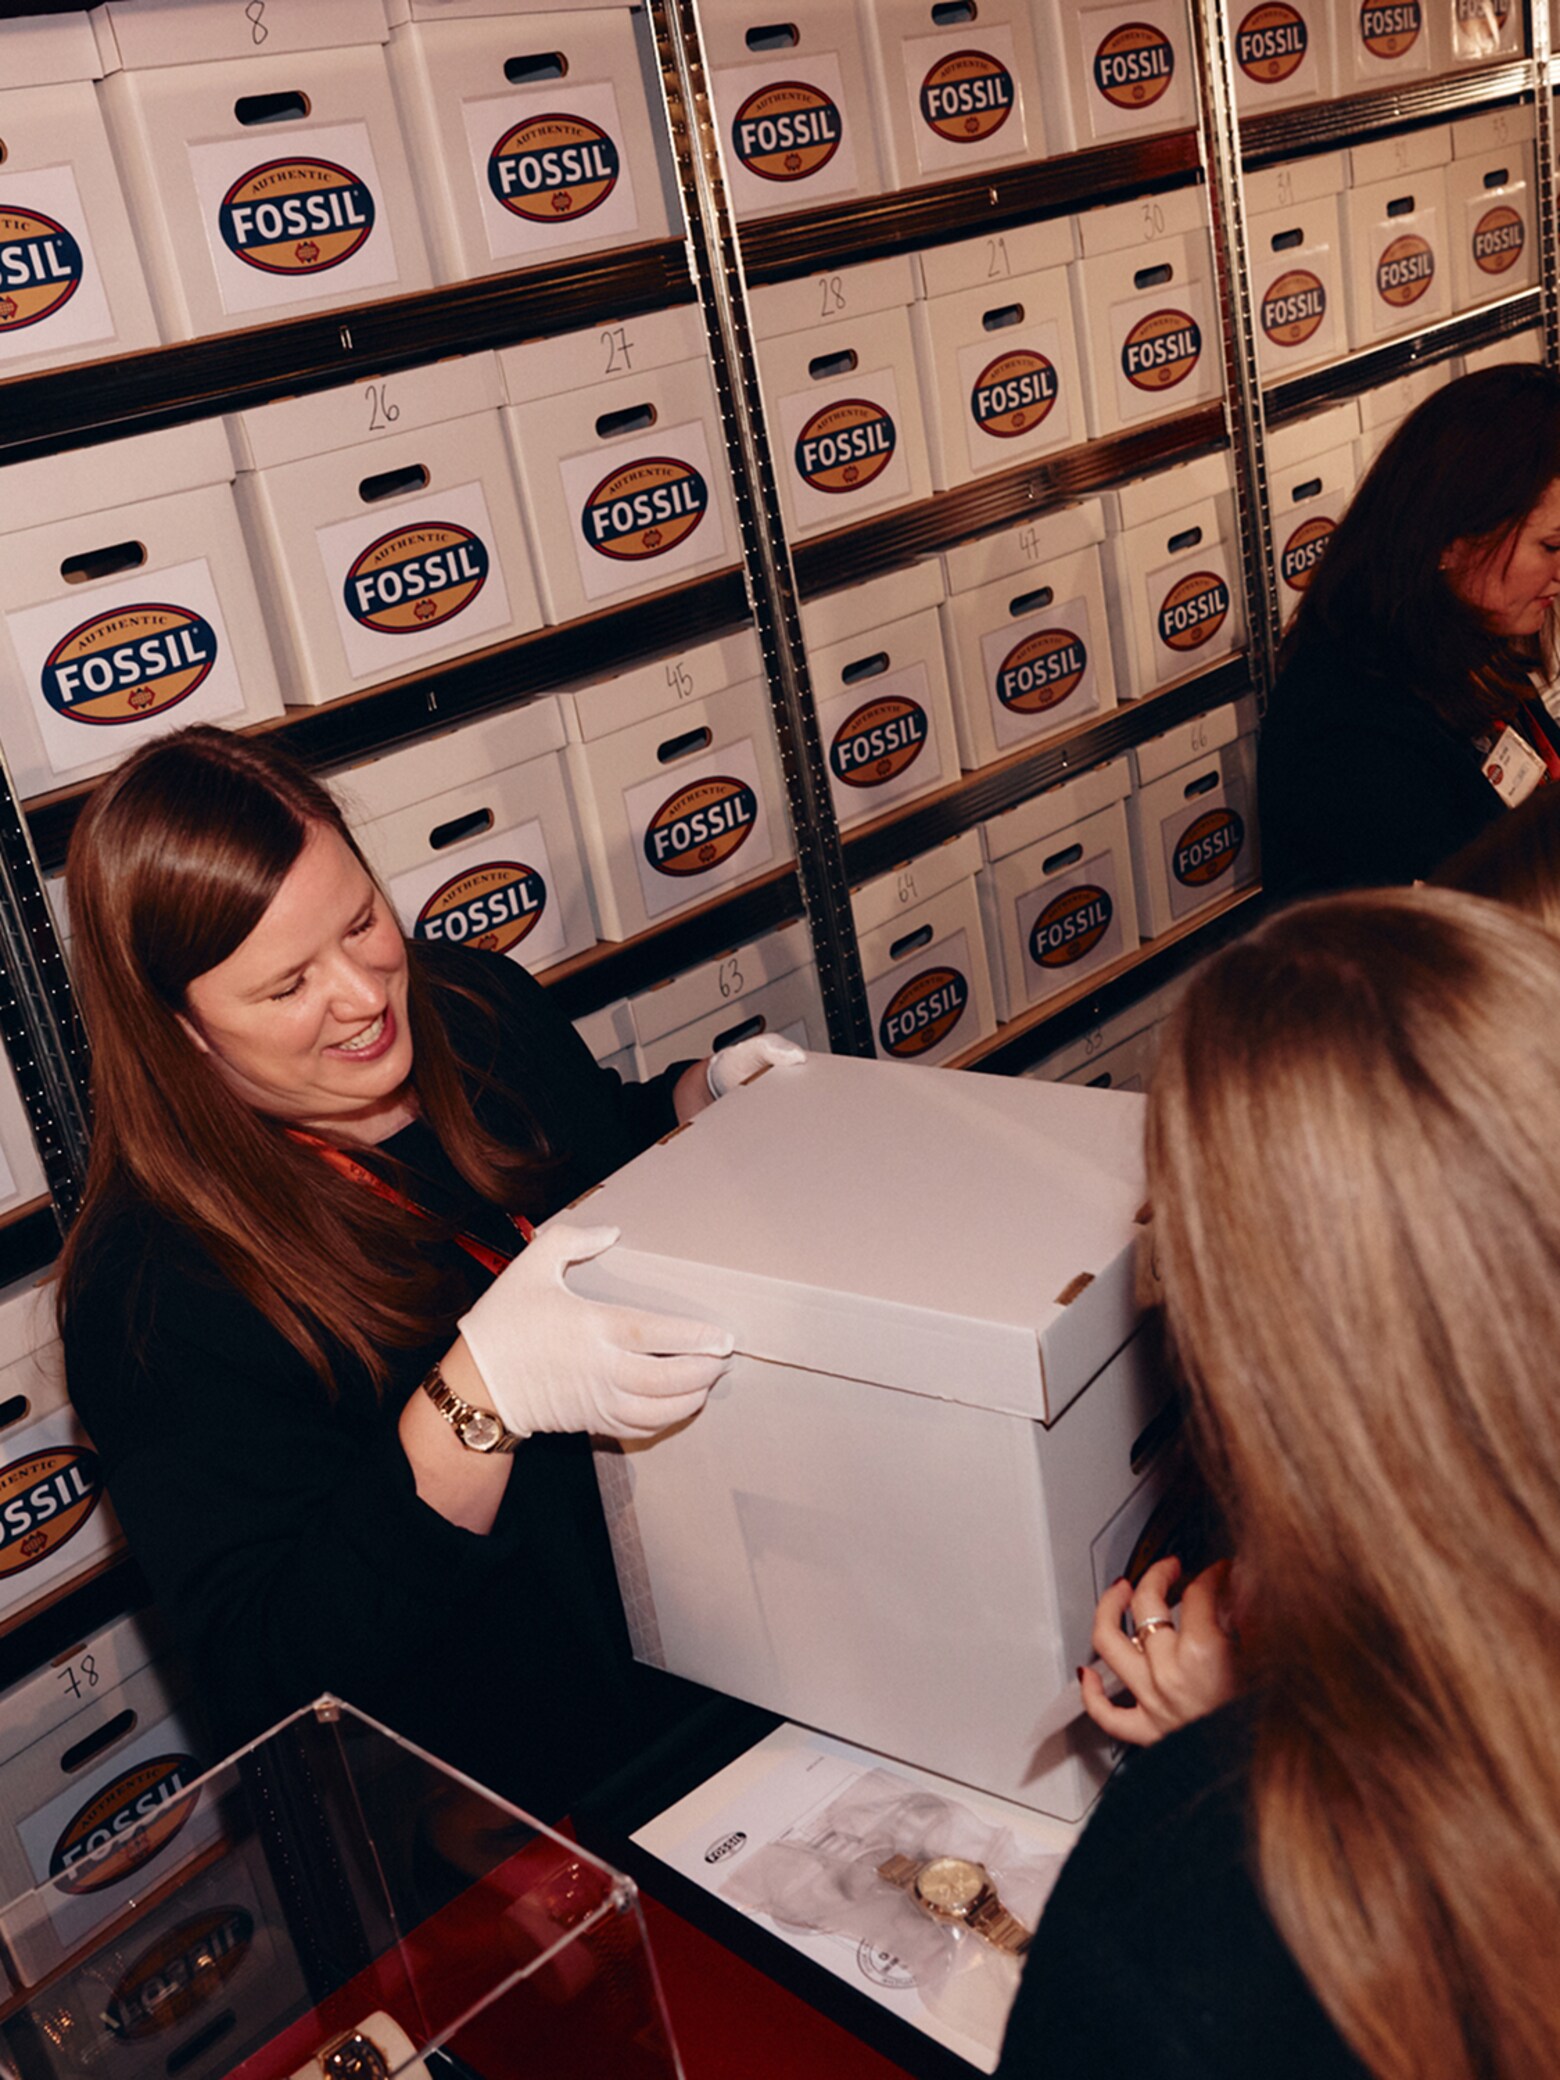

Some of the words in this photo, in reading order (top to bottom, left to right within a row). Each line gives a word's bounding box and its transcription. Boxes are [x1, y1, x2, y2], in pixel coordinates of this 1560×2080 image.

[244, 0, 268, 44] 8
[1364, 6, 1418, 35] FOSSIL
[1241, 26, 1303, 60] FOSSIL
[1100, 47, 1170, 85] FOSSIL
[755, 90, 813, 111] AUTHENTIC
[926, 77, 1008, 117] FOSSIL
[514, 125, 585, 148] AUTHENTIC
[740, 110, 835, 151] FOSSIL
[250, 171, 332, 195] AUTHENTIC
[498, 144, 611, 194] FOSSIL
[231, 190, 365, 244] FOSSIL
[1143, 204, 1164, 239] 30
[987, 237, 1011, 278] 29
[1476, 226, 1520, 256] FOSSIL
[1381, 256, 1431, 287] FOSSIL
[818, 277, 846, 316] 28
[1266, 292, 1323, 327] FOSSIL
[600, 328, 634, 373] 27
[1128, 328, 1197, 372] FOSSIL
[365, 384, 399, 431] 26
[978, 372, 1052, 418] FOSSIL
[816, 409, 869, 429] AUTHENTIC
[802, 423, 890, 471] FOSSIL
[609, 467, 674, 494] AUTHENTIC
[592, 481, 700, 538] FOSSIL
[373, 533, 449, 564] AUTHENTIC
[1019, 527, 1041, 560] 47
[355, 547, 480, 612] FOSSIL
[78, 616, 168, 650] AUTHENTIC
[1164, 590, 1225, 636] FOSSIL
[55, 629, 206, 702] FOSSIL
[666, 662, 693, 698] 45
[1003, 646, 1081, 698] FOSSIL
[837, 716, 921, 769] FOSSIL
[668, 786, 726, 817] AUTHENTIC
[653, 797, 751, 859] FOSSIL
[1179, 826, 1239, 874] FOSSIL
[442, 871, 509, 905] AUTHENTIC
[897, 873, 917, 903] 64
[424, 881, 538, 939] FOSSIL
[1036, 901, 1107, 955] FOSSIL
[719, 959, 744, 997] 63
[885, 984, 962, 1044] FOSSIL
[57, 1655, 99, 1699] 78
[81, 1765, 161, 1830] AUTHENTIC
